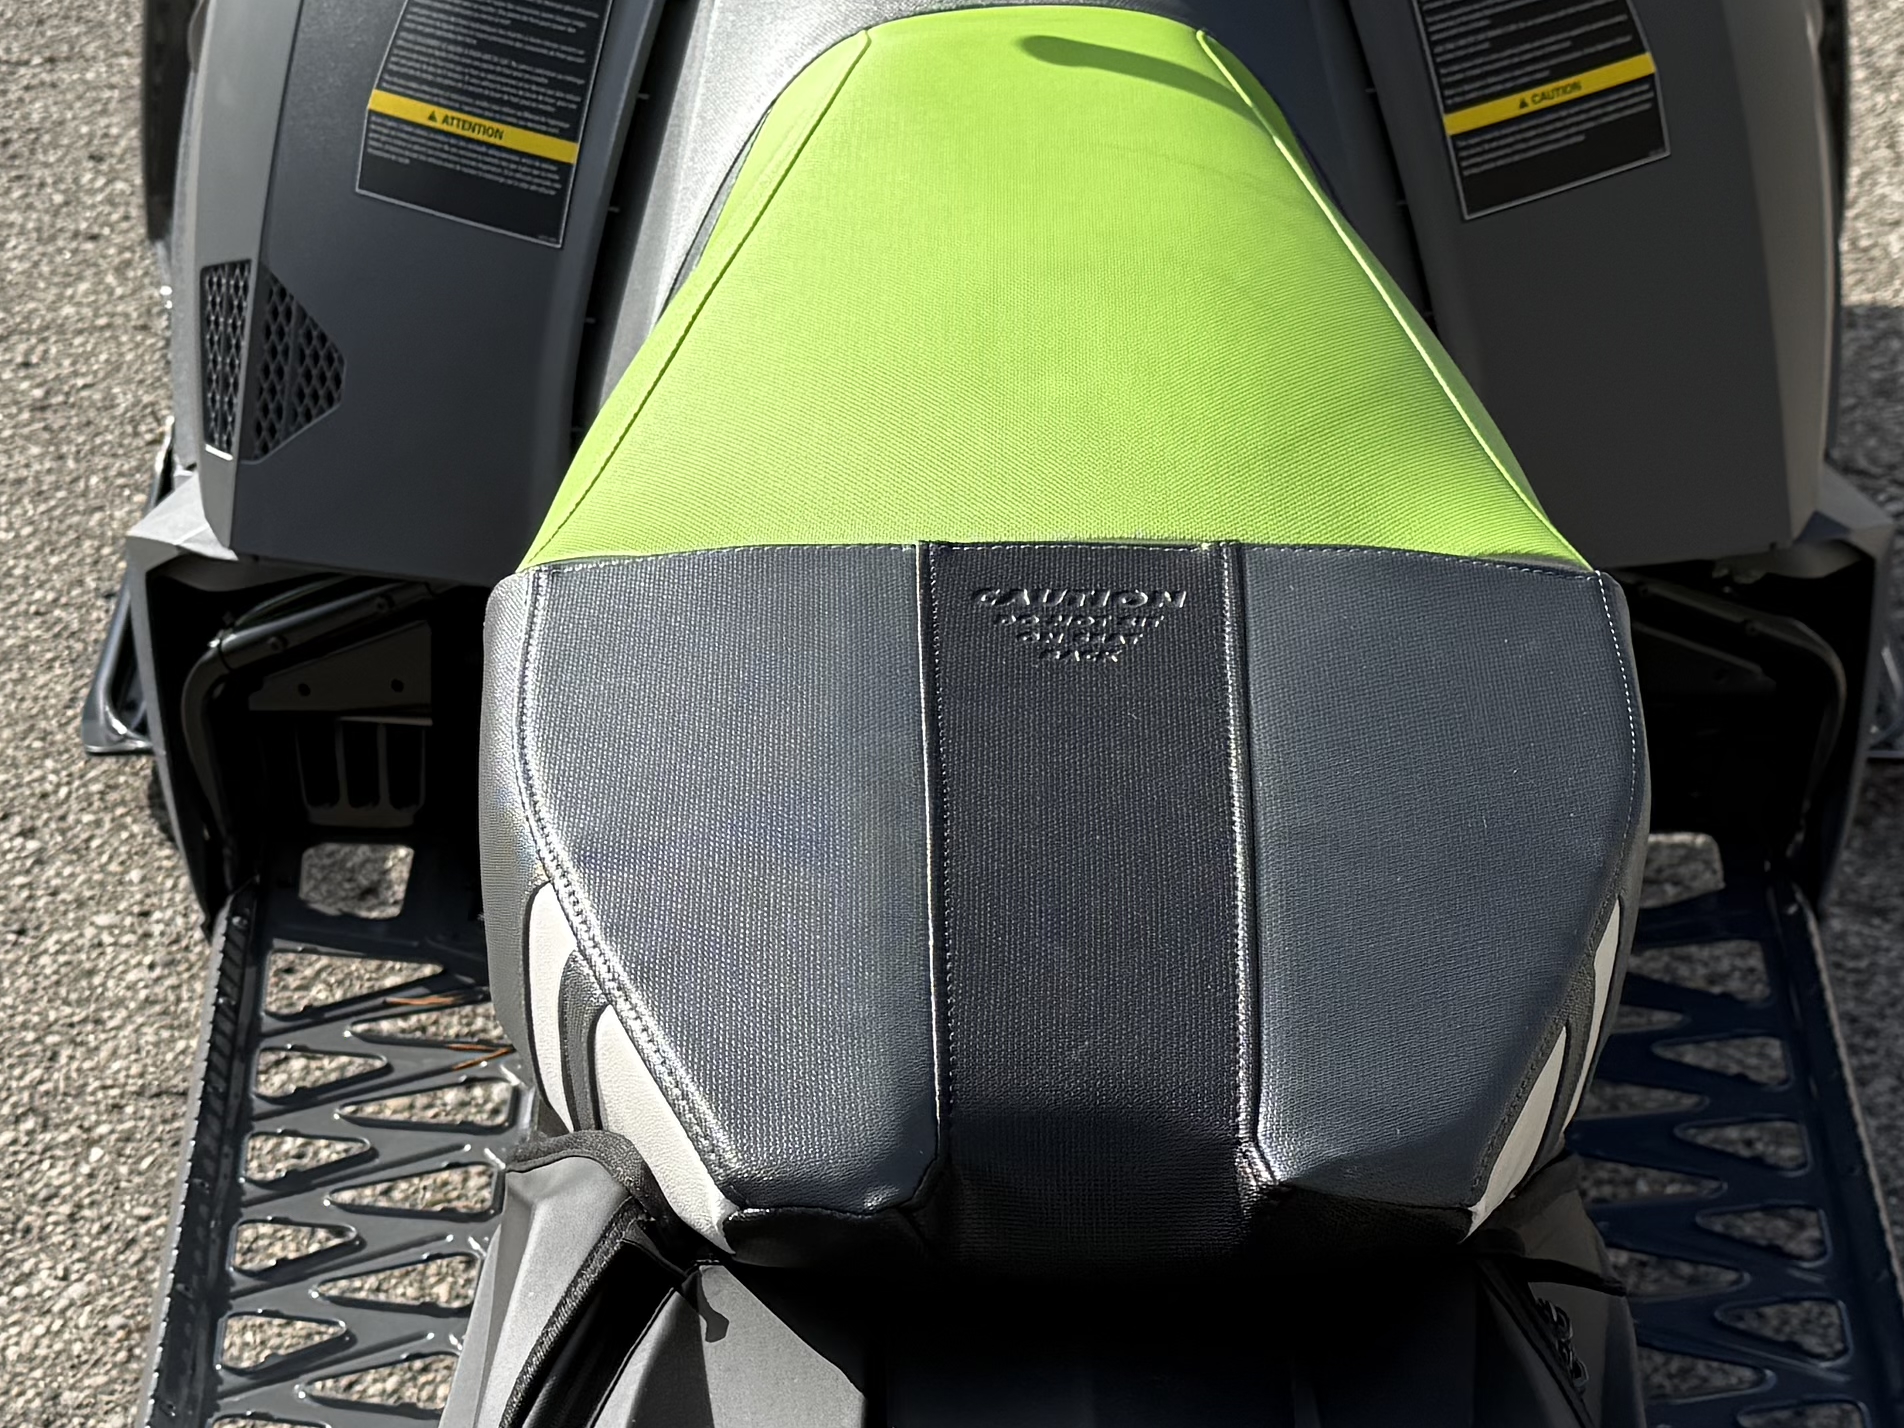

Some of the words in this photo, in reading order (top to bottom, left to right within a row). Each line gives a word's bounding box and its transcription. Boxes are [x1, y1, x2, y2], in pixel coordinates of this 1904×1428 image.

[1531, 80, 1583, 105] CAUTION
[440, 113, 505, 141] ATTENTION
[972, 587, 1187, 609] CAUTION
